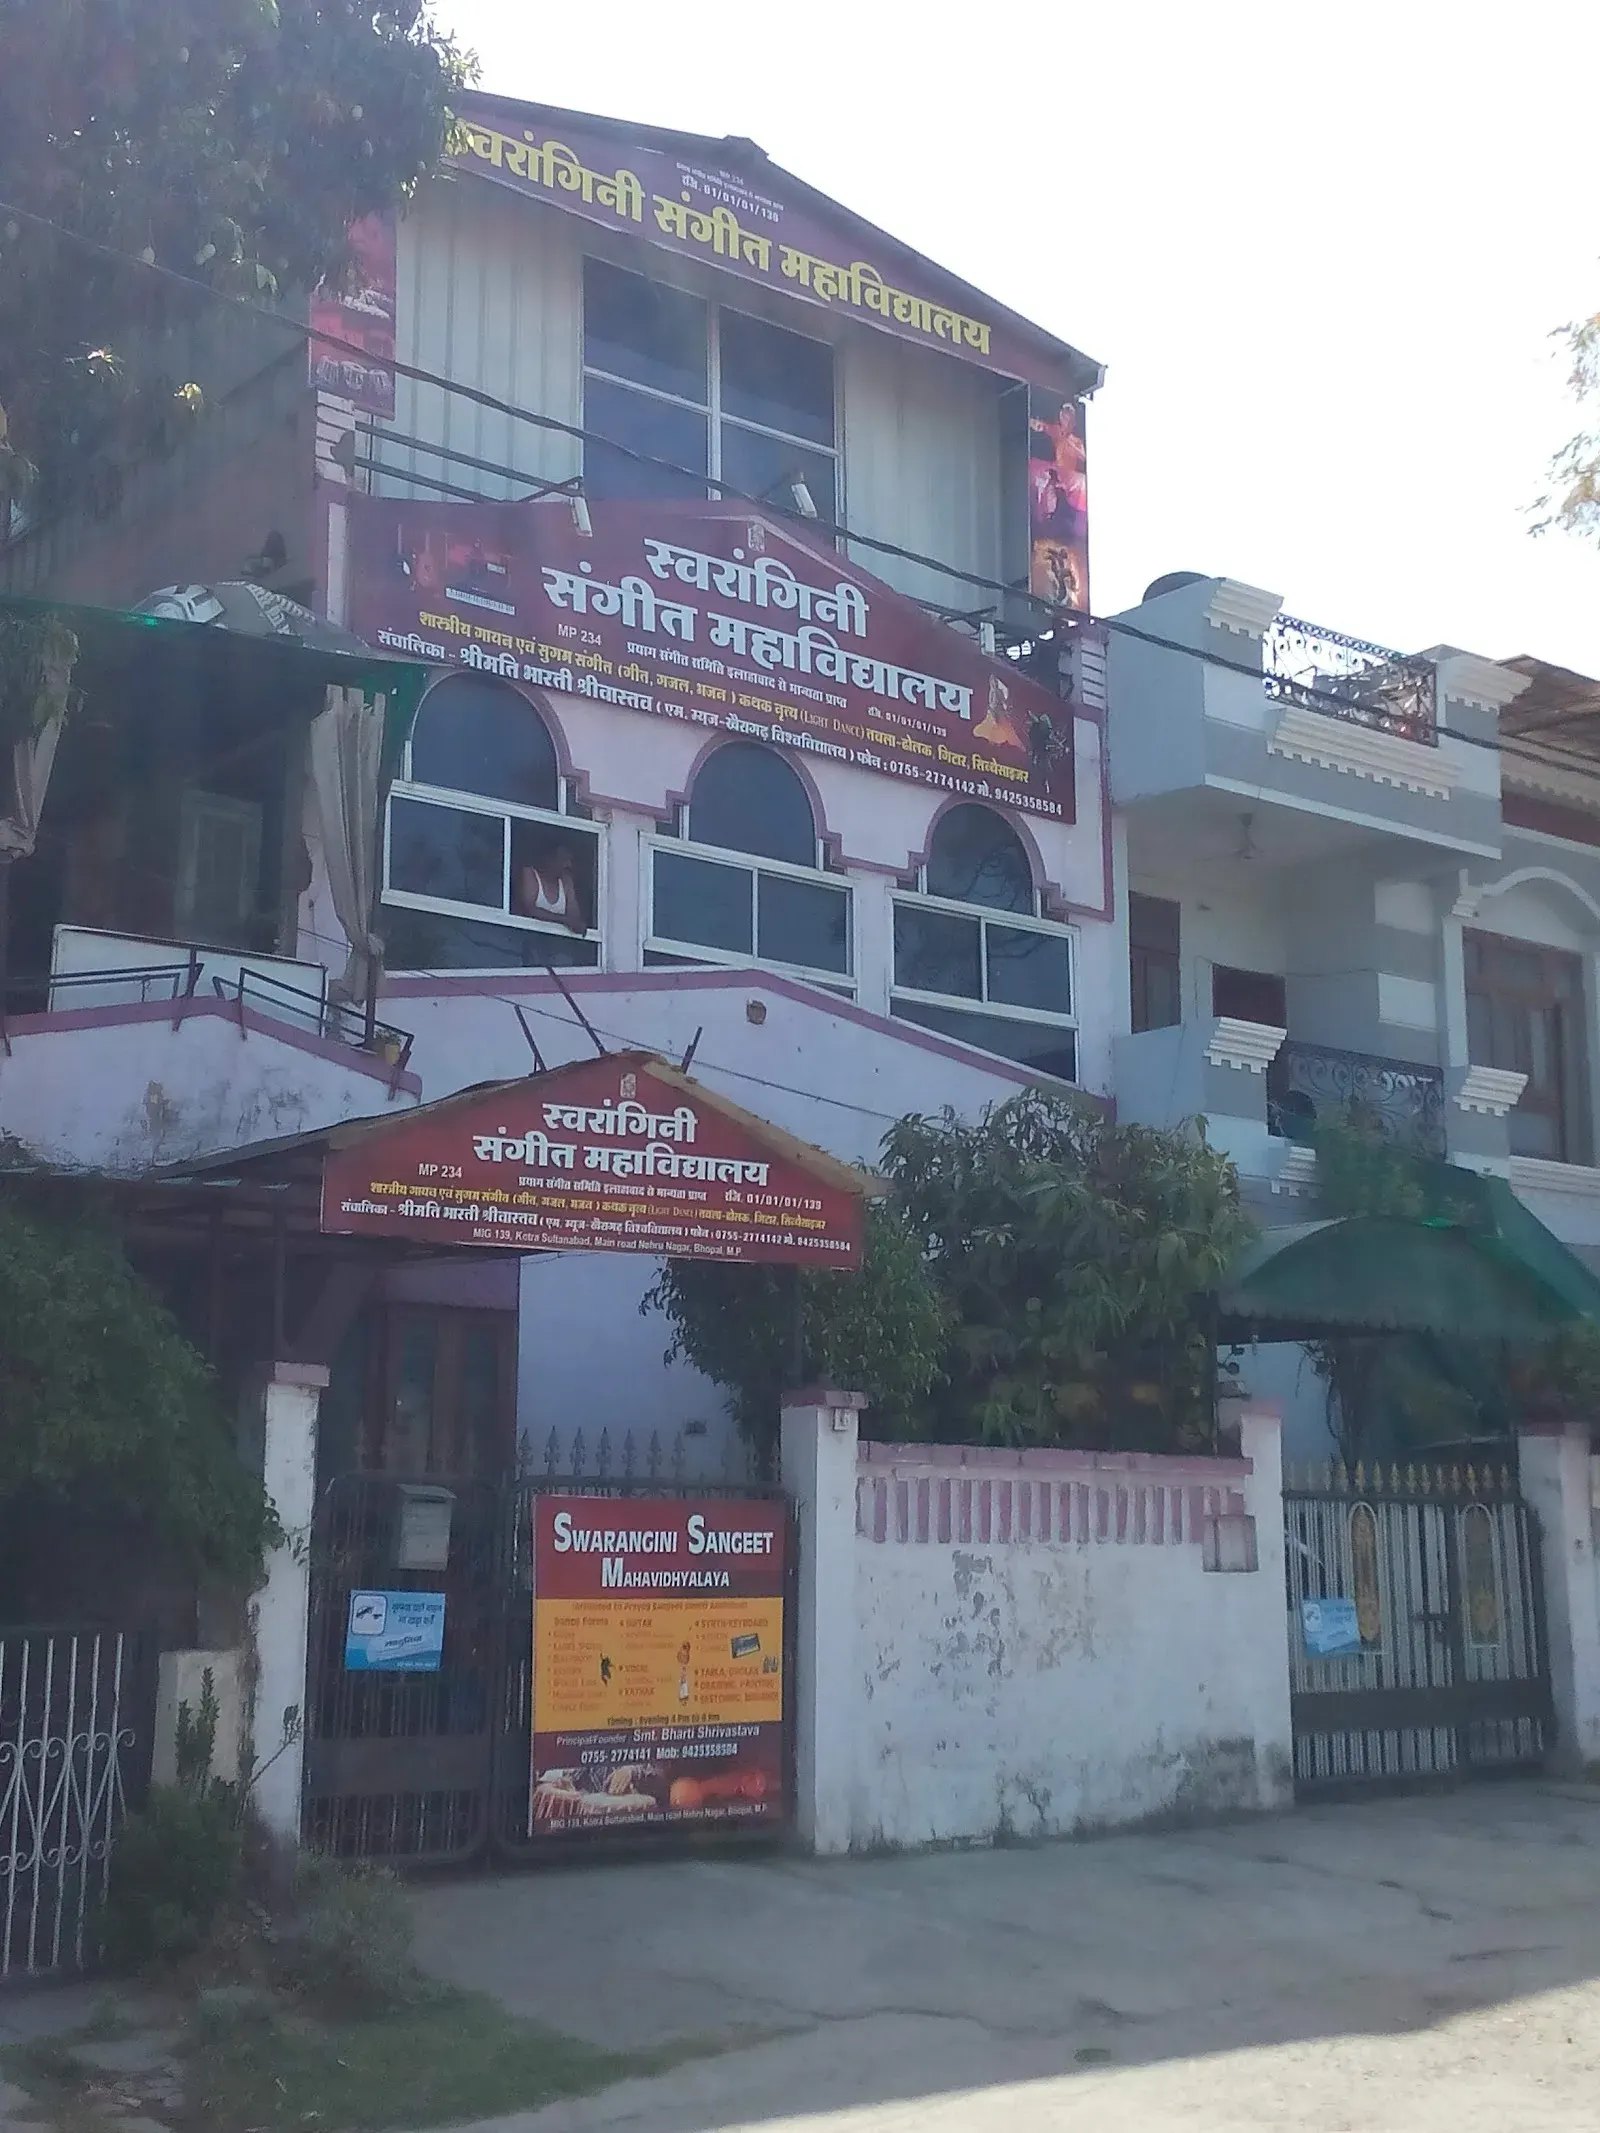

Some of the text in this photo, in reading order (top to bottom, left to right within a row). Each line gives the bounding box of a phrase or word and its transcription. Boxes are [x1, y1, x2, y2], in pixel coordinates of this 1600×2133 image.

[653, 191, 773, 273] संगीत
[778, 242, 993, 357] महाविद्यालय
[644, 538, 870, 638] स्वरांगिनी
[541, 561, 974, 720] संगीत महाविद्यालय
[557, 623, 602, 646] MP 234
[419, 611, 472, 638] शास्त्रीय
[474, 626, 513, 649] गायन
[515, 635, 537, 656] एवं
[538, 642, 573, 665] सुगम
[575, 649, 614, 676] संगीत
[738, 692, 773, 714] कथक
[626, 641, 657, 659] प्रयाग
[659, 647, 689, 666] संगीत
[691, 656, 725, 676] समिति
[777, 676, 787, 692] से
[790, 682, 824, 703] मान्यता
[825, 693, 847, 709] प्राप्त
[377, 627, 446, 660] संचालिका
[460, 644, 520, 679] श्रीमति
[523, 664, 573, 693] भारती
[577, 674, 653, 713] श्रीवास्तव
[771, 723, 848, 761] विश्वविद्यालय
[857, 748, 882, 771] फोन
[889, 761, 976, 796] 0755-2774142
[542, 1099, 699, 1143] स्वरांगिनी
[418, 1163, 463, 1178] MP 234
[473, 1126, 769, 1186] संगीत महाविद्यालय
[340, 1198, 388, 1215] संचालिका
[397, 1199, 441, 1219] श्रीमति
[443, 1204, 479, 1222] भारती
[481, 1205, 538, 1225] श्रीवास्तव
[746, 1194, 822, 1211] 01/01/01/139
[473, 1228, 492, 1240] MIG
[594, 1236, 615, 1248] Main
[554, 1512, 774, 1554] SWARANGINI SANGEET
[632, 1729, 657, 1742] Smt.
[661, 1727, 695, 1740] Bharti
[697, 1725, 761, 1739] Shrivastava
